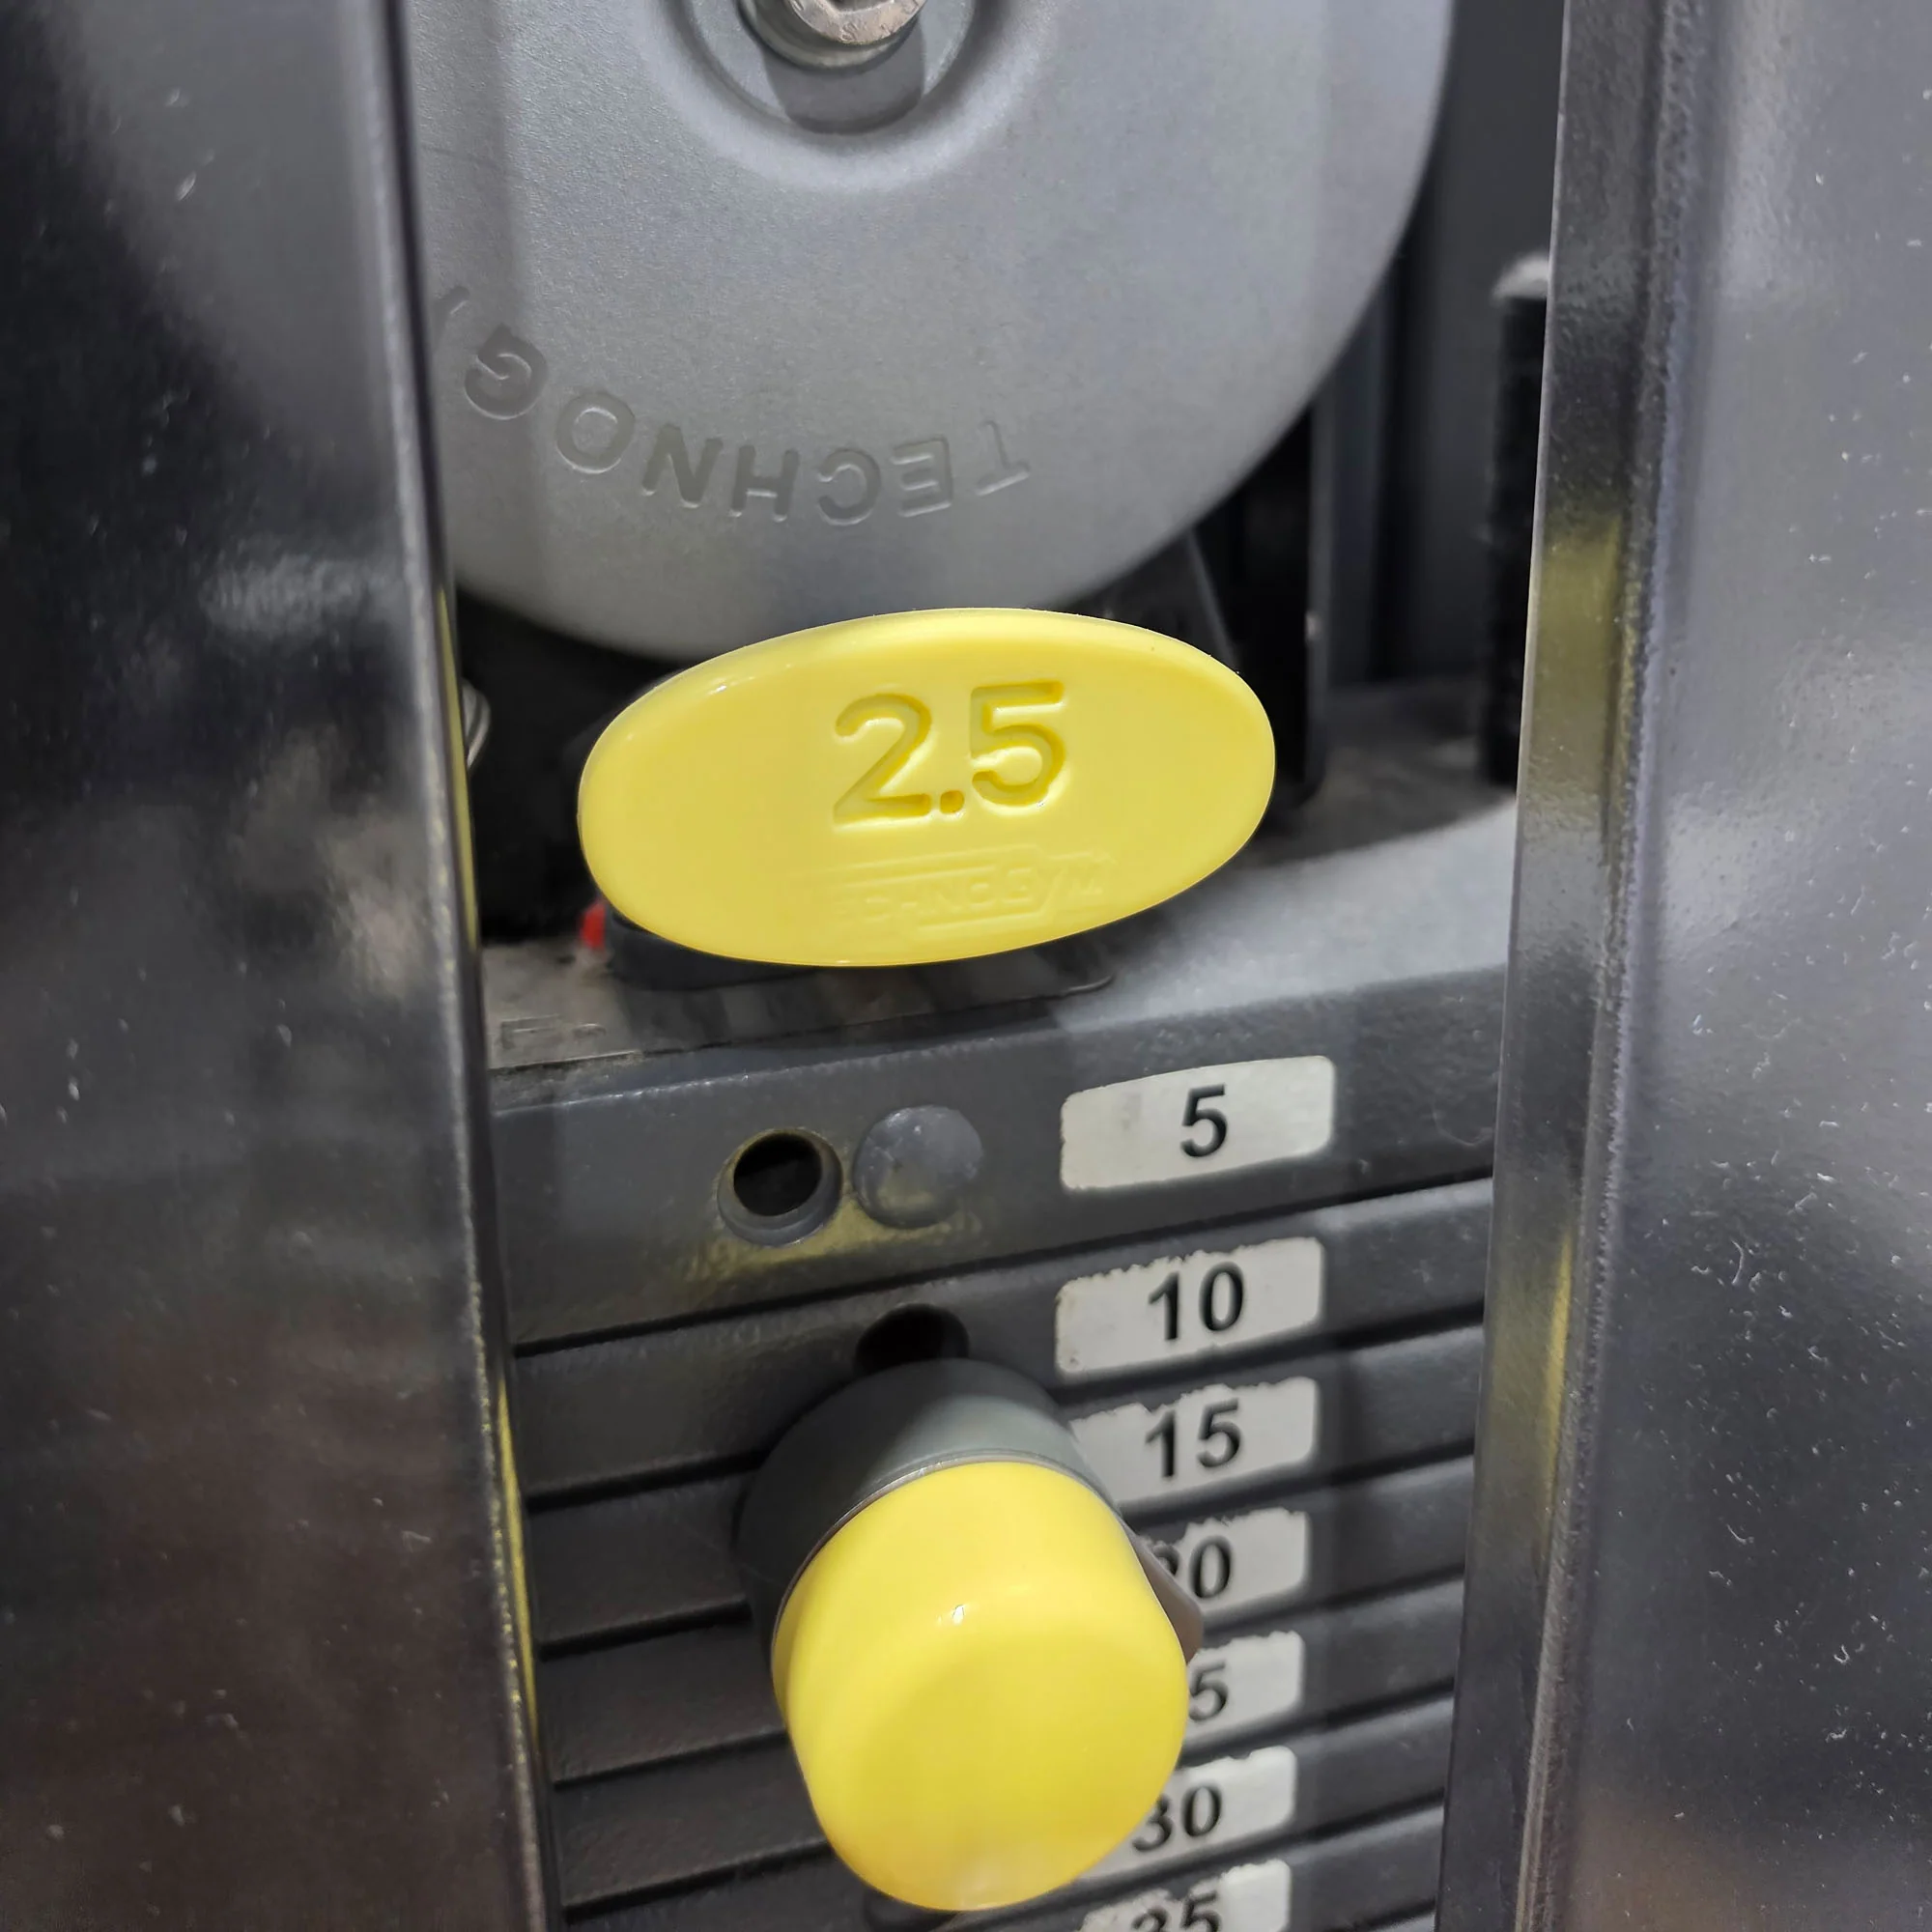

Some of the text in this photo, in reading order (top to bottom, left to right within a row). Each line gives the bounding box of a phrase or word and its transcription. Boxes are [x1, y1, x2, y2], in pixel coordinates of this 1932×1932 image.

[833, 679, 1067, 823] 2.5
[1180, 1084, 1228, 1158] 5
[1148, 1261, 1245, 1341] 10
[1145, 1398, 1241, 1478] 15
[1188, 1660, 1229, 1721] 5
[1131, 1783, 1223, 1853] 30
